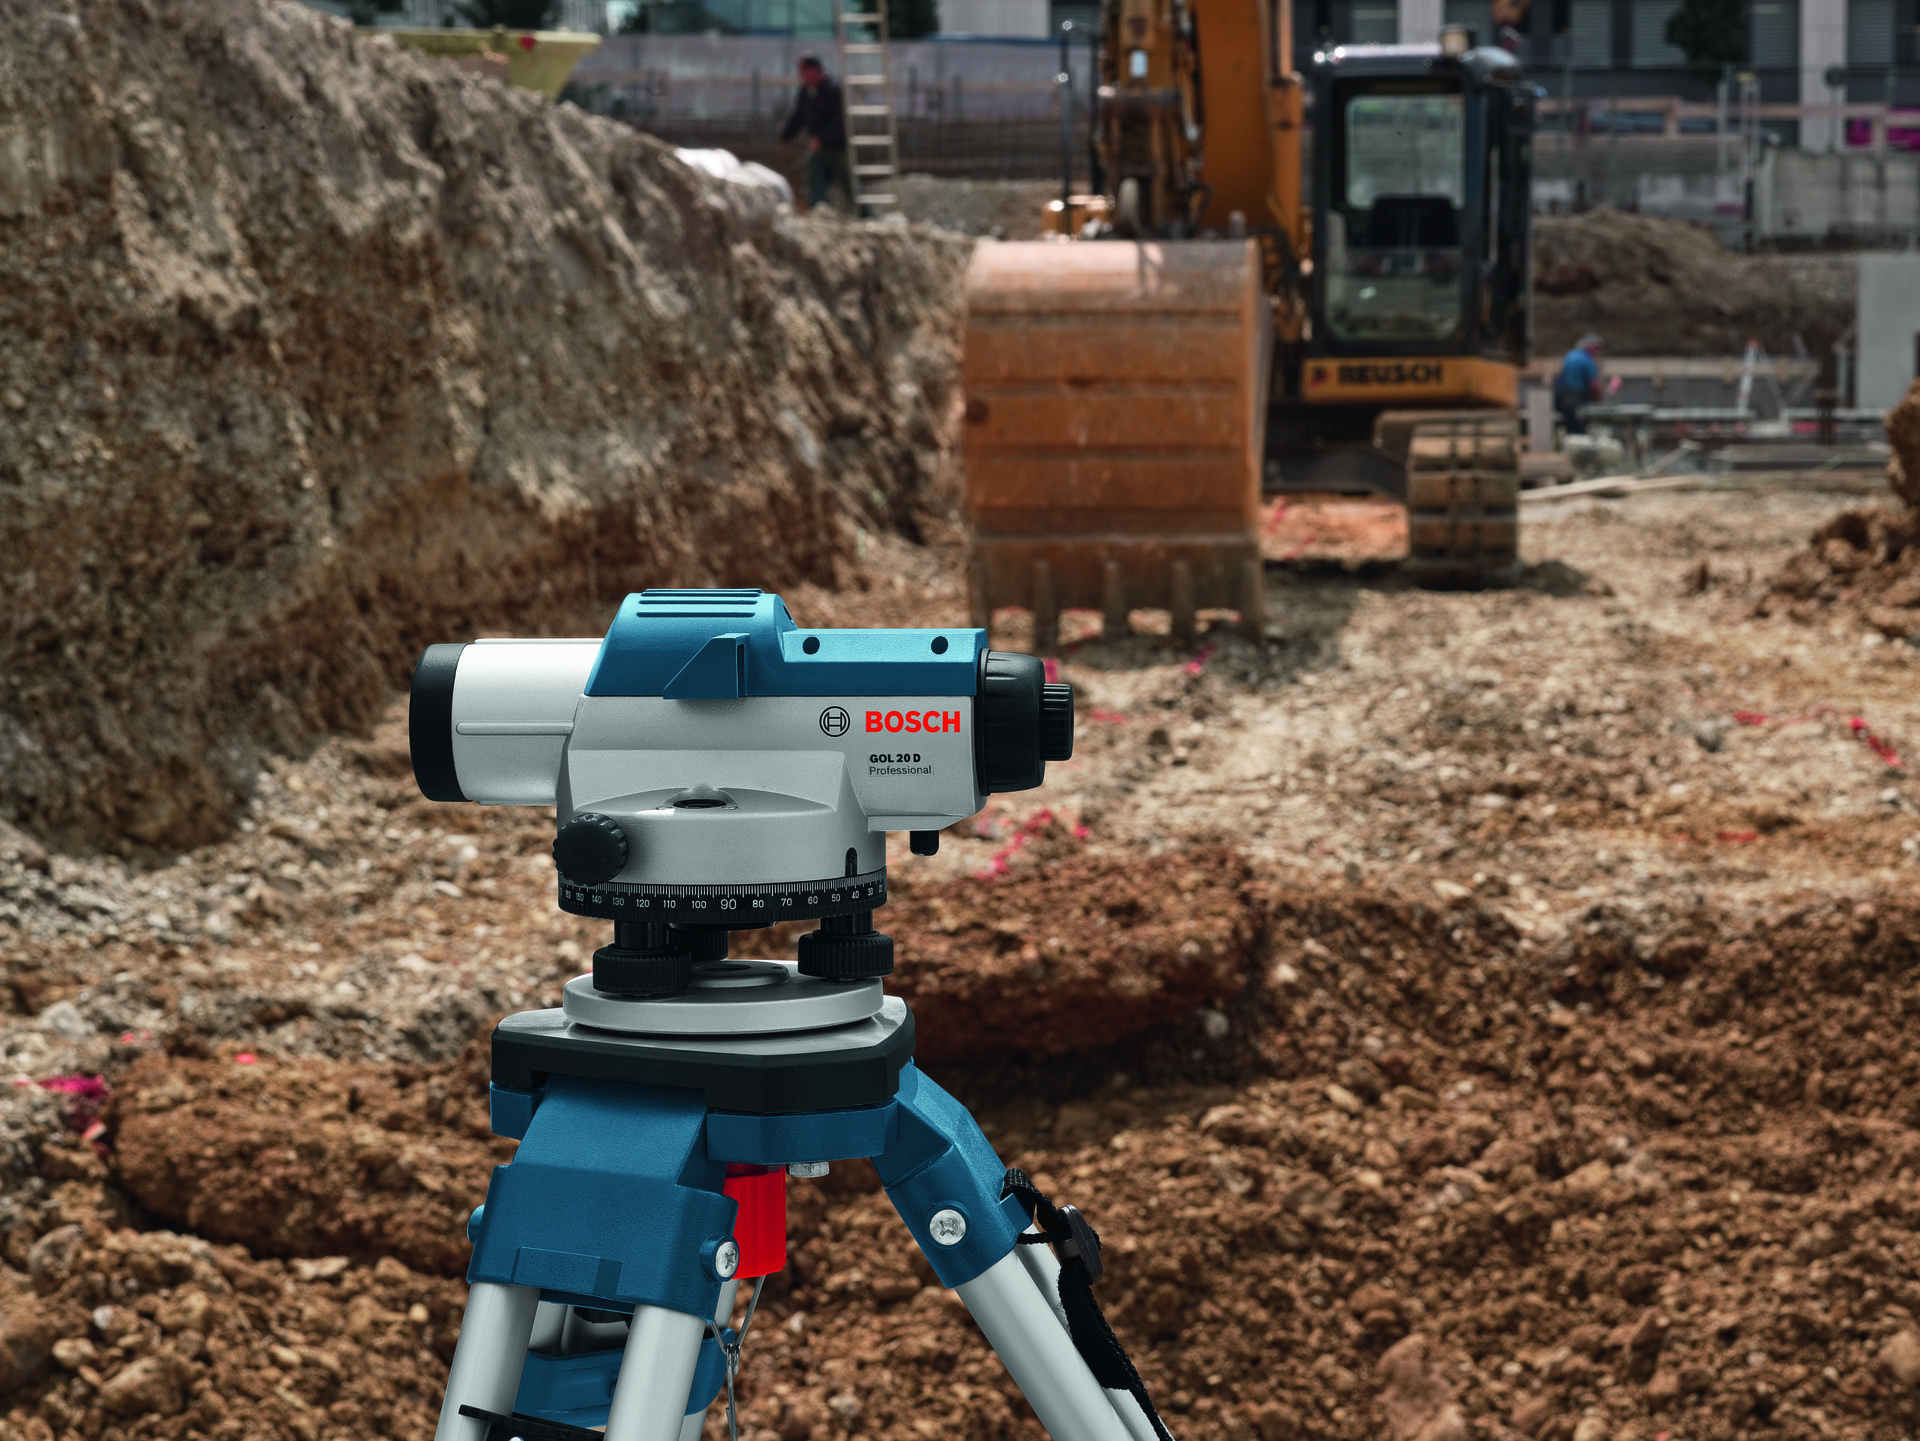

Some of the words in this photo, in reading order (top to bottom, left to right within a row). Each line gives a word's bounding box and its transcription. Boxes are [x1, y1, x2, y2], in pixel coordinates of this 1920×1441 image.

[865, 710, 961, 733] BOSCH
[869, 754, 894, 763] GOL
[896, 753, 911, 763] 20
[913, 753, 921, 763] D
[869, 765, 932, 775] Professional
[575, 892, 584, 901] 150
[591, 894, 603, 904] 140
[612, 897, 625, 906] 130
[636, 899, 650, 908] 120
[663, 900, 676, 908] 110
[691, 900, 707, 909] 100
[720, 898, 737, 910] 90
[752, 899, 764, 908] 80
[781, 898, 793, 906] 70
[807, 896, 819, 905] 60
[831, 893, 841, 902] 50
[851, 890, 860, 899] 40
[867, 886, 874, 896] 30
